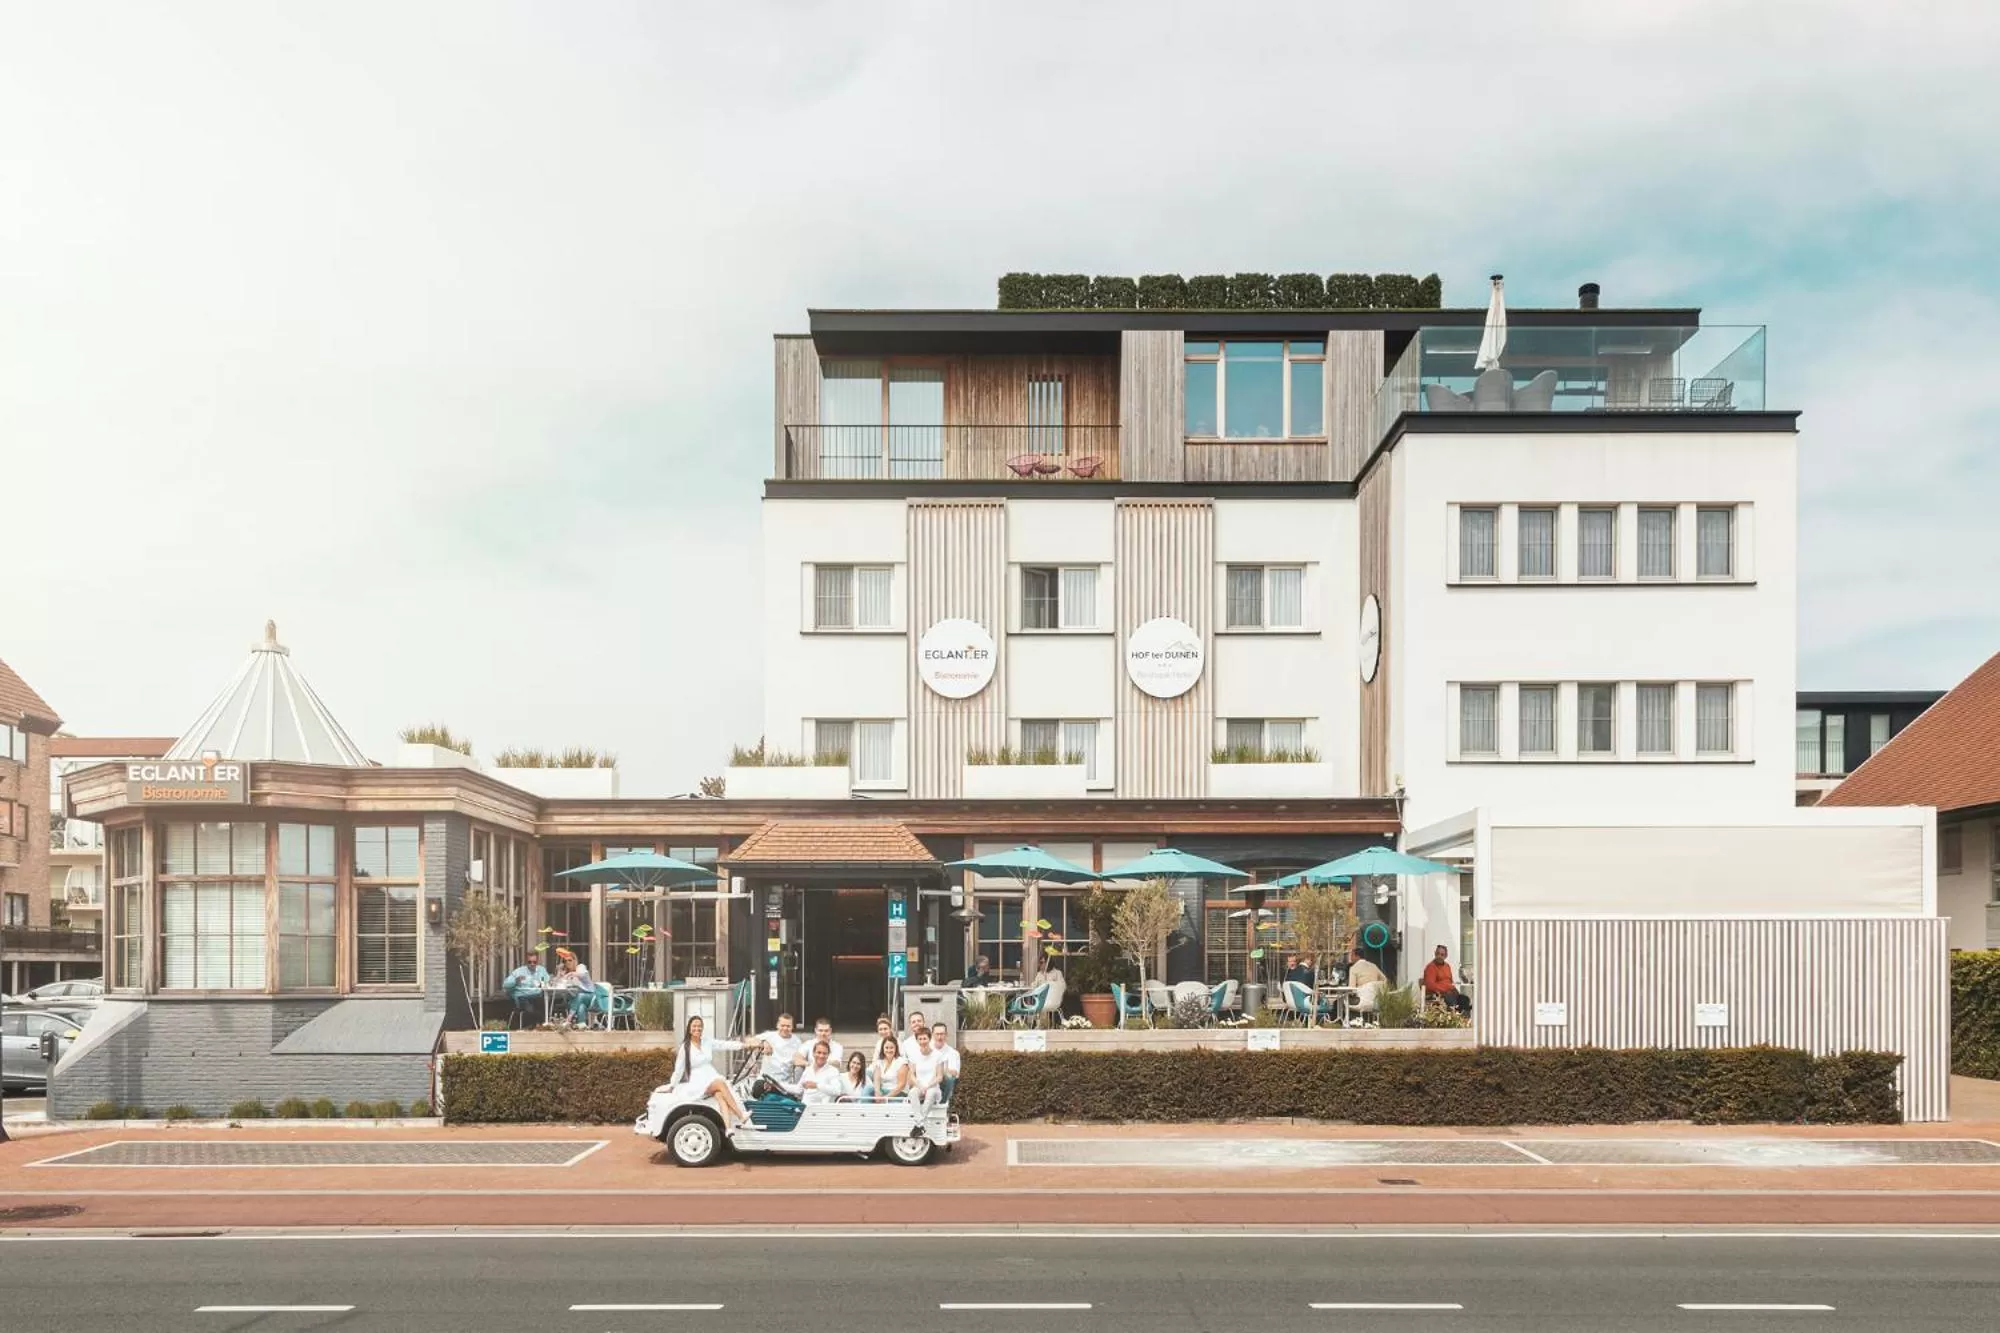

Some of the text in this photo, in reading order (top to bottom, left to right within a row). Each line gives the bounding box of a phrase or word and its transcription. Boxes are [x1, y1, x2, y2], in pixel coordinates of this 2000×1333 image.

[1131, 651, 1198, 659] HOF ter DUINEN
[142, 785, 228, 800] Bistronomie
[892, 903, 903, 915] H
[894, 955, 902, 964] P
[483, 1036, 492, 1048] P
